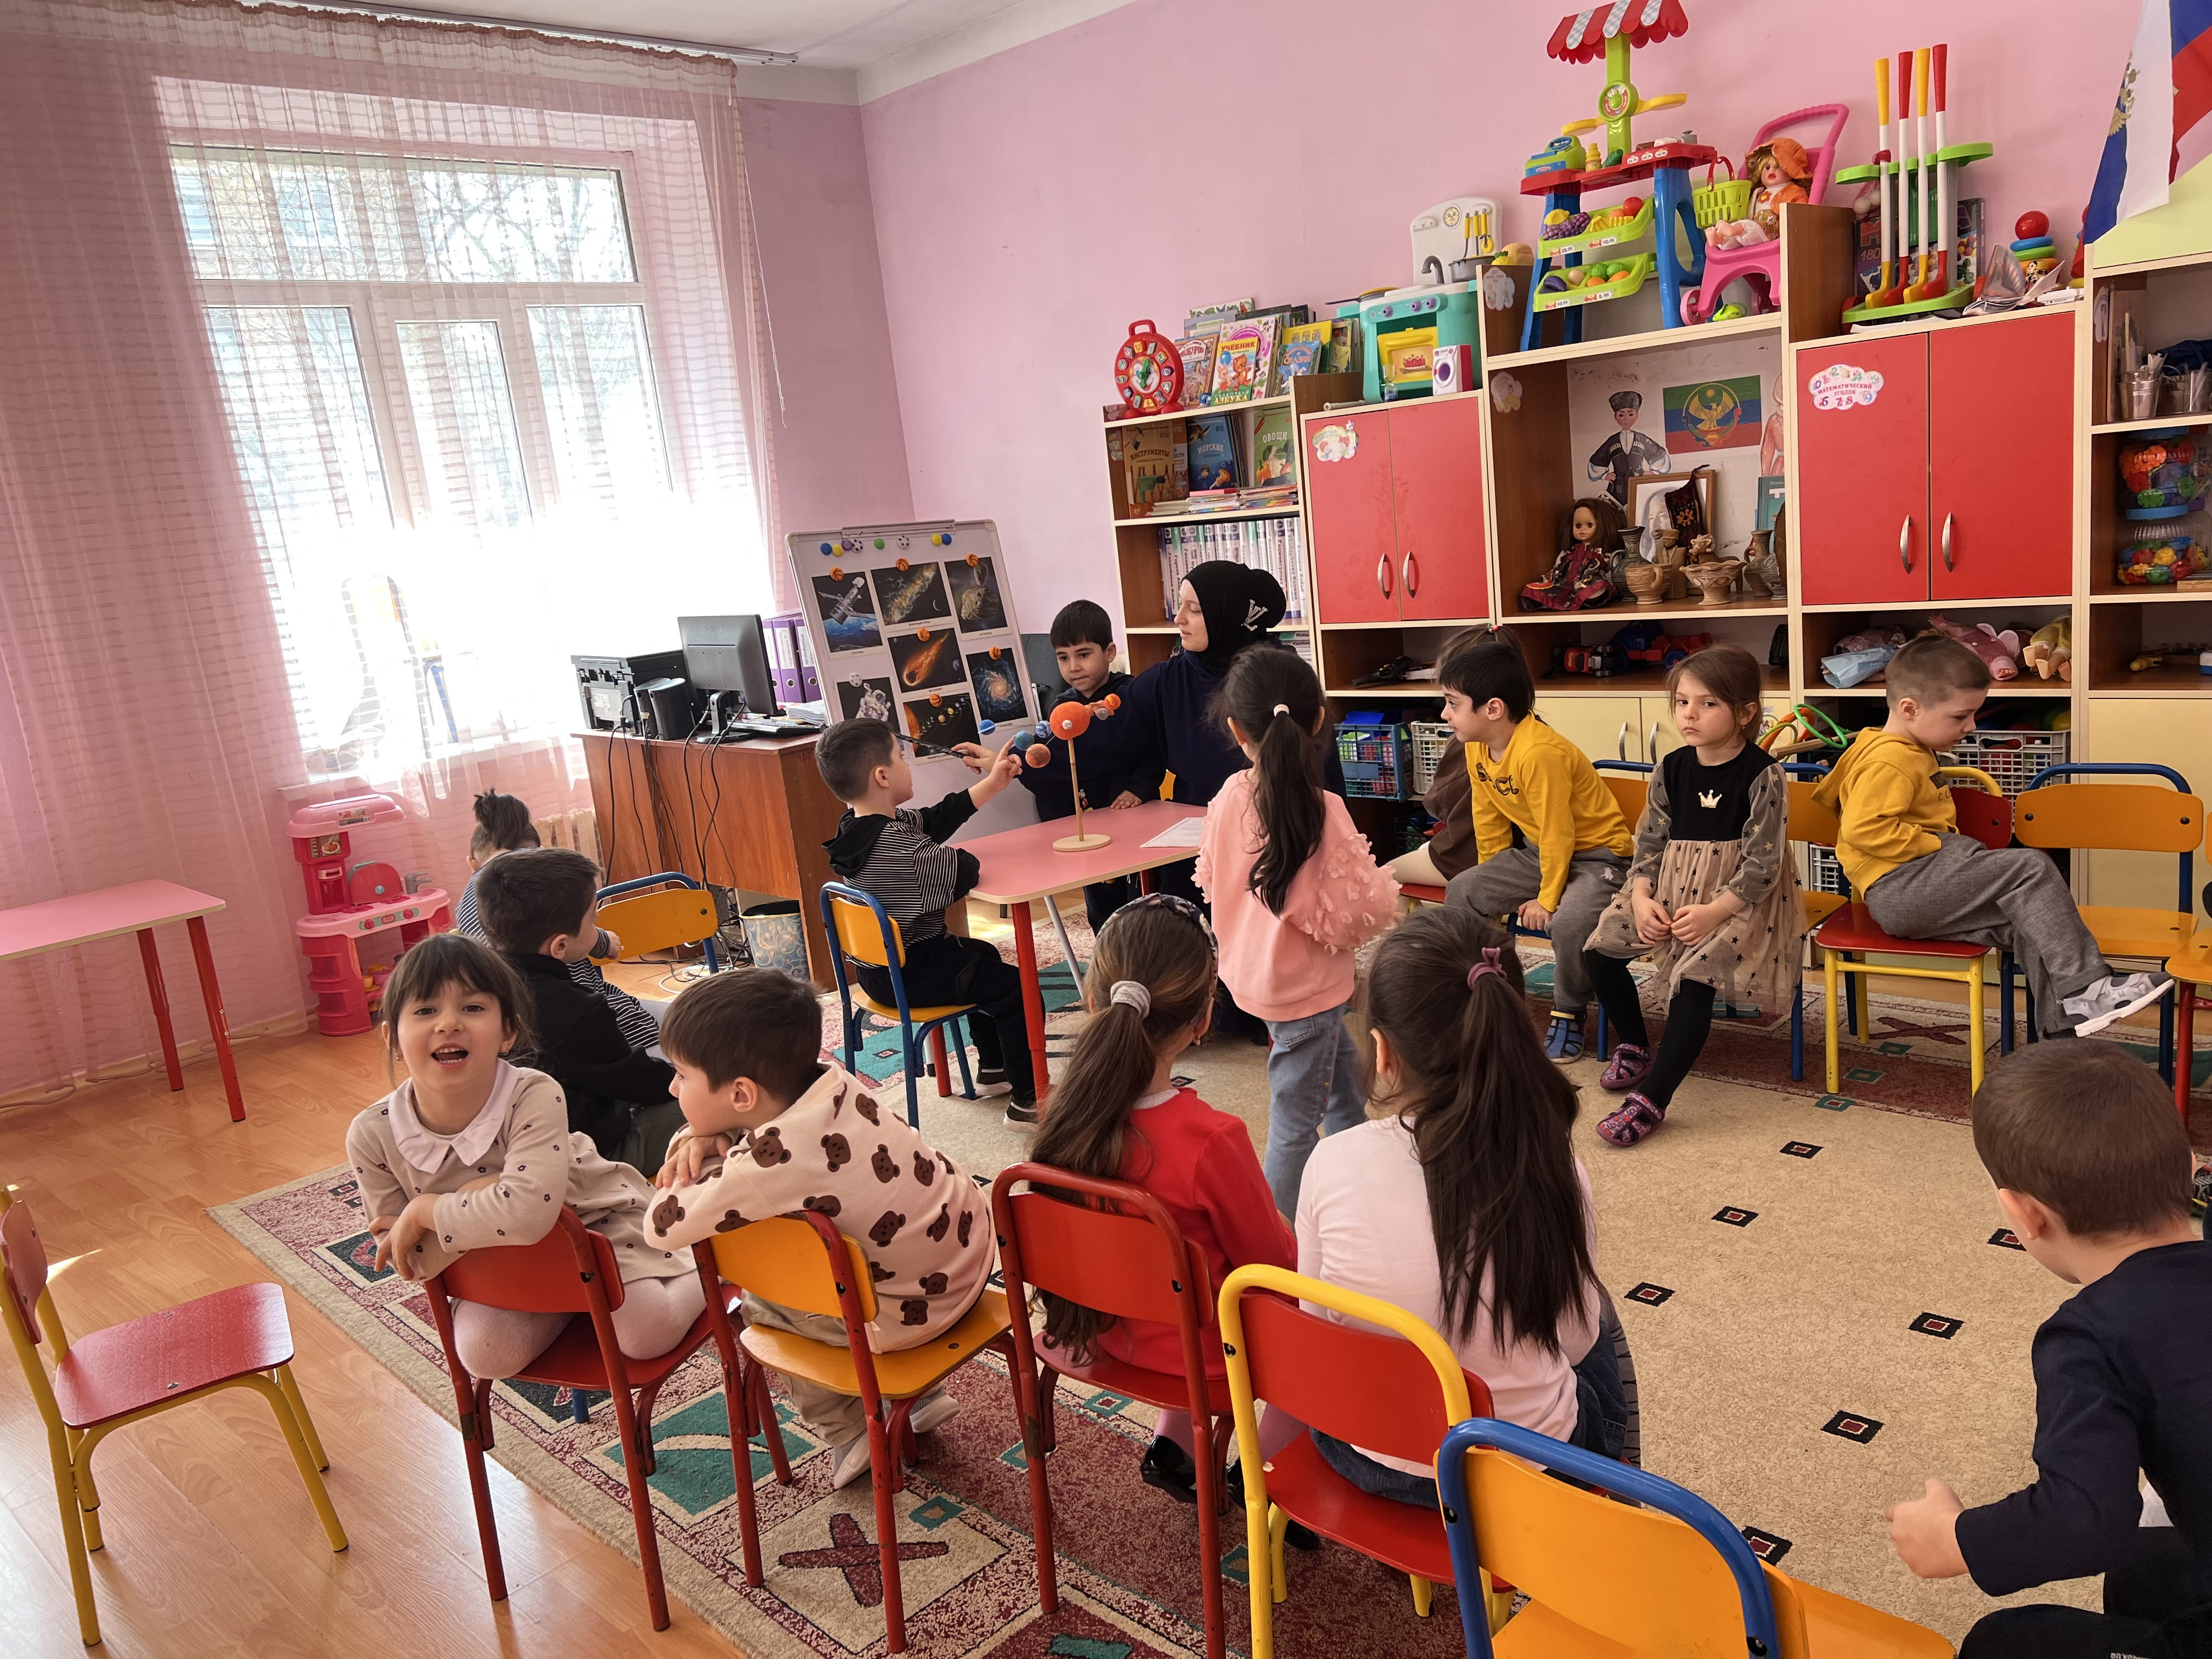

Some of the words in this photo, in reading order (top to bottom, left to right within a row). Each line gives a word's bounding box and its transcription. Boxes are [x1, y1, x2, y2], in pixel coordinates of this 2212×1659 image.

[1221, 341, 1255, 352] УЧЕБНИК
[1831, 366, 1839, 376] 2
[1852, 372, 1863, 382] 4
[1164, 383, 1169, 392] 4
[1818, 383, 1872, 394] МАТЕМАТИЧЕСКИЙ
[1214, 393, 1248, 405] АЗБУКА
[1822, 396, 1829, 406] 6
[1836, 397, 1842, 407] 7
[1847, 396, 1853, 404] 8
[1263, 431, 1288, 443] ОВОЩИ
[1130, 449, 1170, 461] ИНСТРУМЕНТЫ
[1198, 443, 1223, 455] МОРСКИЕ
